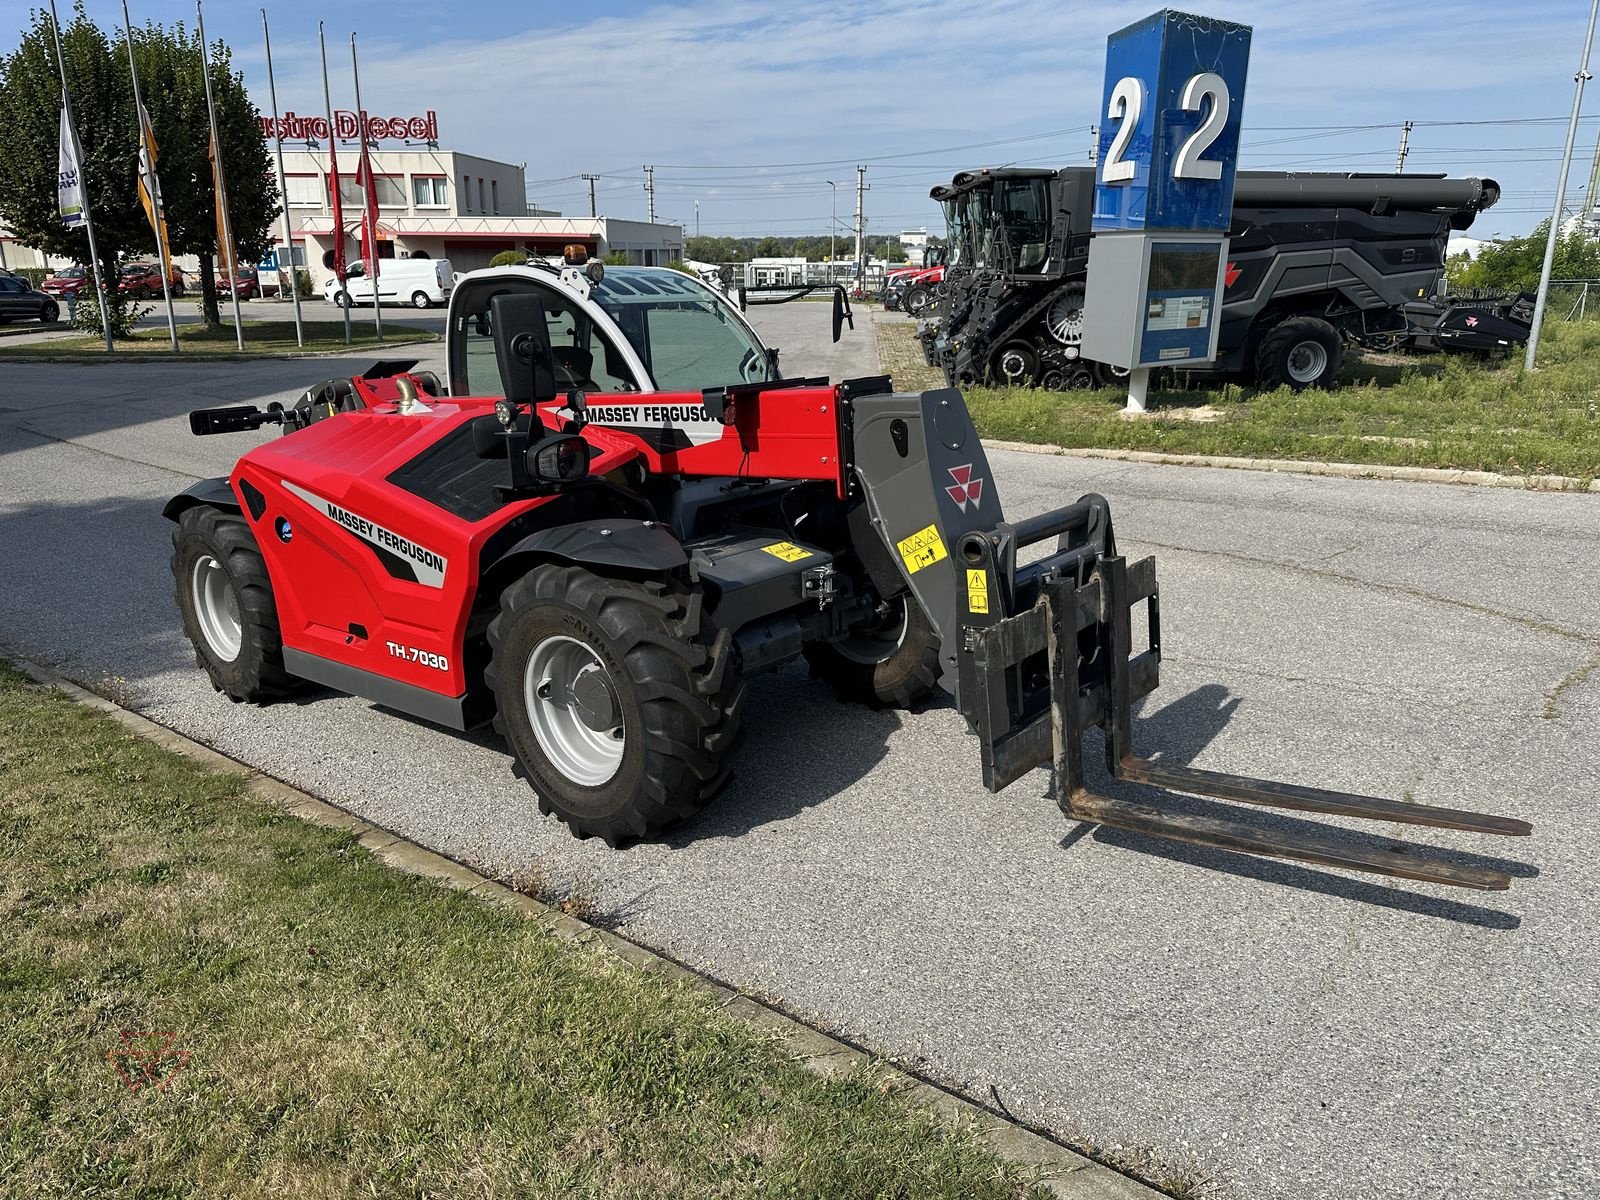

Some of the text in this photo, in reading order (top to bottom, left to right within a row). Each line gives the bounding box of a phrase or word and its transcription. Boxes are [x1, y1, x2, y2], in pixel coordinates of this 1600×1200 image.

[334, 110, 438, 140] Diesel
[1102, 76, 1141, 182] 2
[1174, 72, 1229, 179] 2
[586, 406, 716, 423] MASSEY FERGUSO
[327, 503, 444, 573] MASSEY FERGUSON
[386, 641, 449, 671] TH.7030
